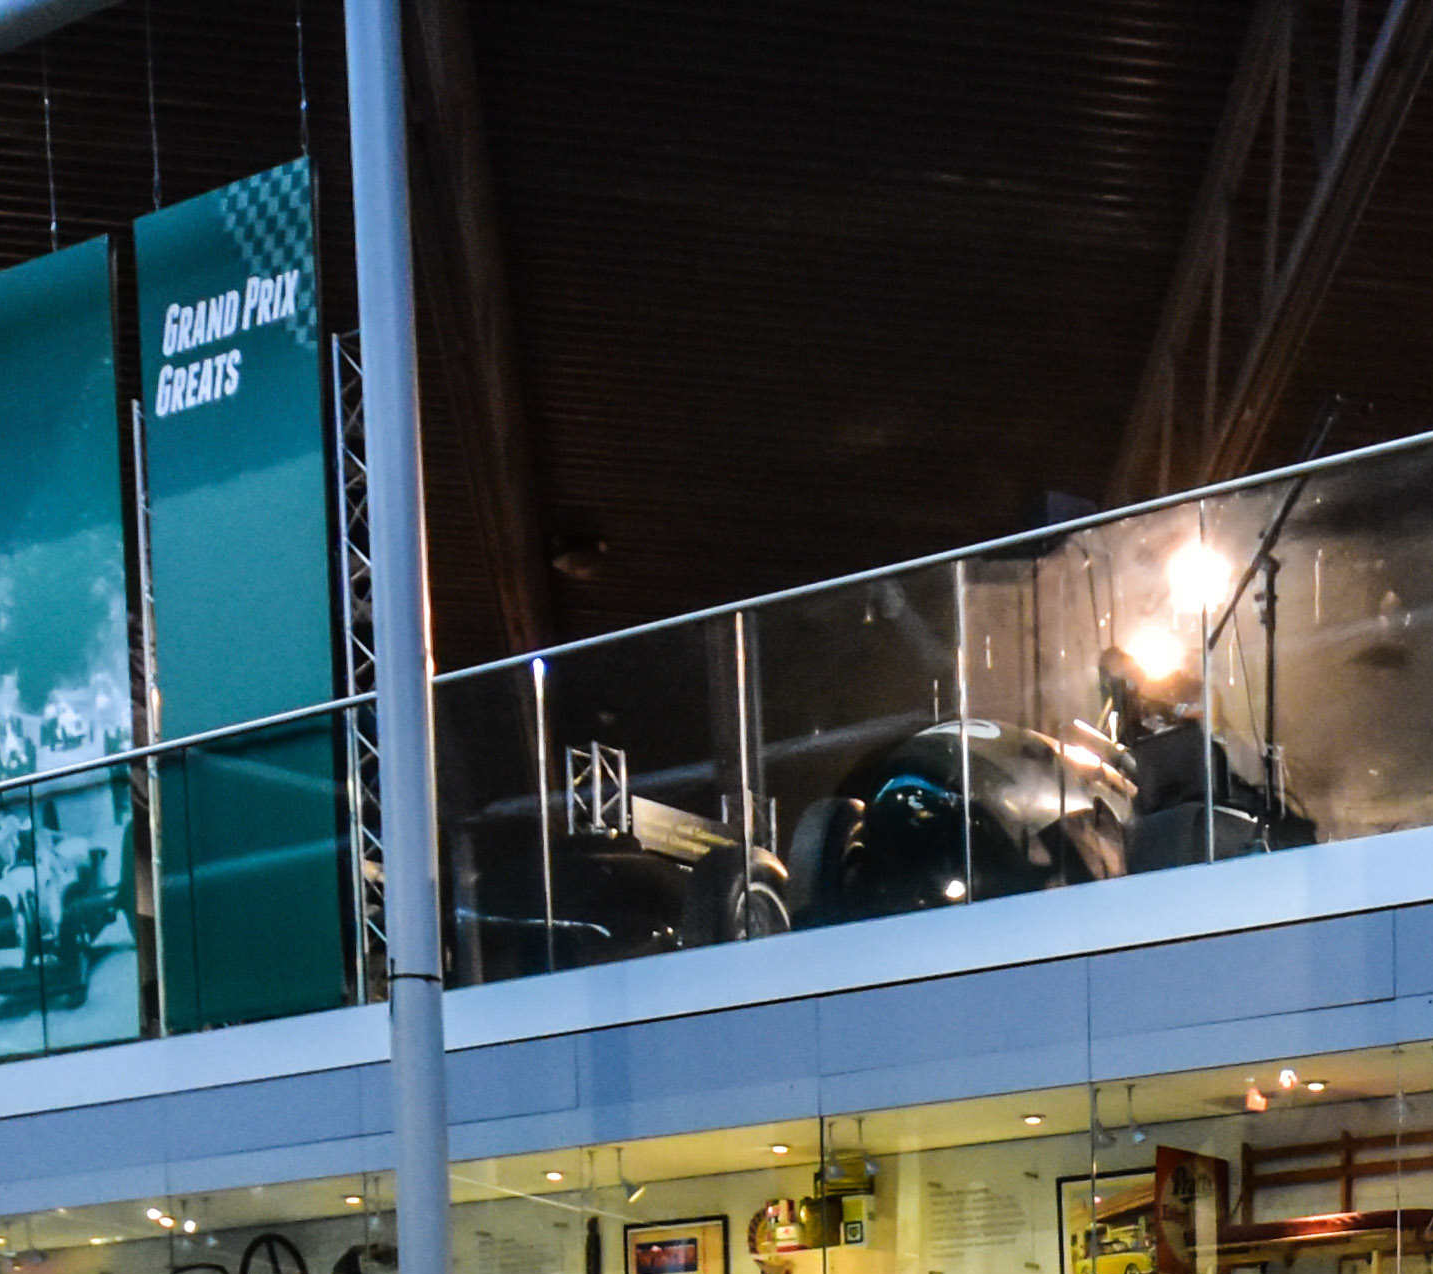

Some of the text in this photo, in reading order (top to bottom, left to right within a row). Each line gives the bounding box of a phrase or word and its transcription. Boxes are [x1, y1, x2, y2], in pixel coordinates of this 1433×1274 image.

[161, 268, 301, 358] GRAND PRIX
[154, 348, 242, 418] GREATS
